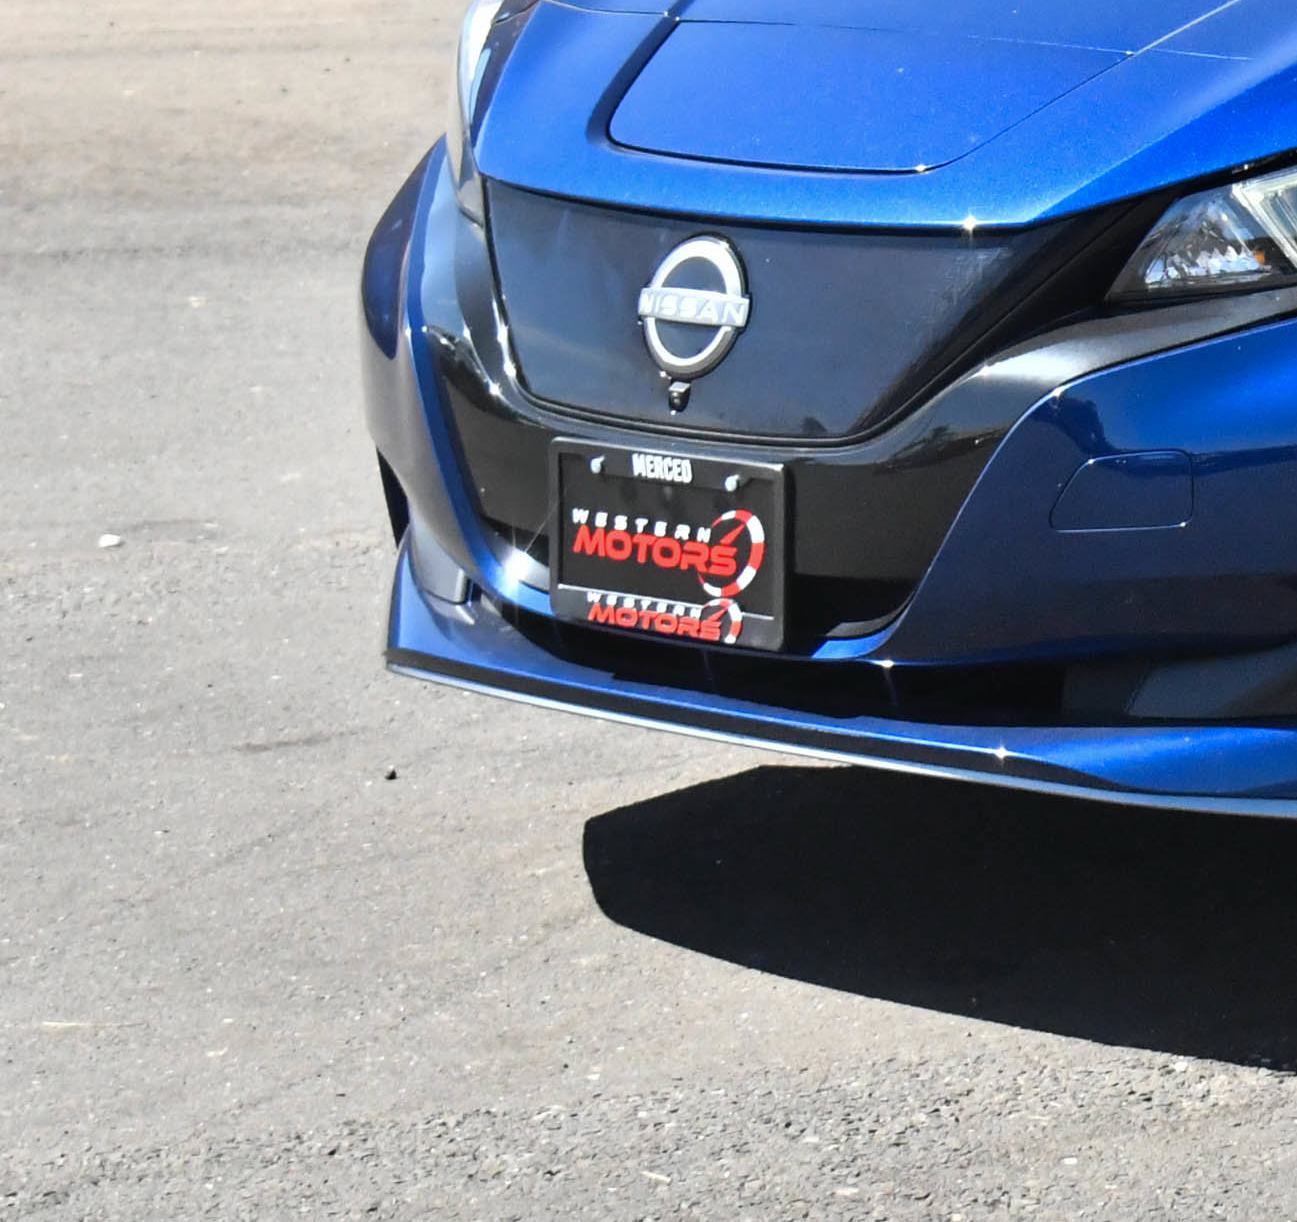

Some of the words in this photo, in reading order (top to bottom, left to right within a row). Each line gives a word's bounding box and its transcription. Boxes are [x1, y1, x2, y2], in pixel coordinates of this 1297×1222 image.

[641, 293, 747, 325] NISSAN
[632, 453, 692, 483] MERCED
[572, 508, 712, 543] WESTERN
[573, 524, 737, 577] MOTORS
[587, 591, 701, 619] WESTERN
[588, 603, 722, 642] MOTORS
